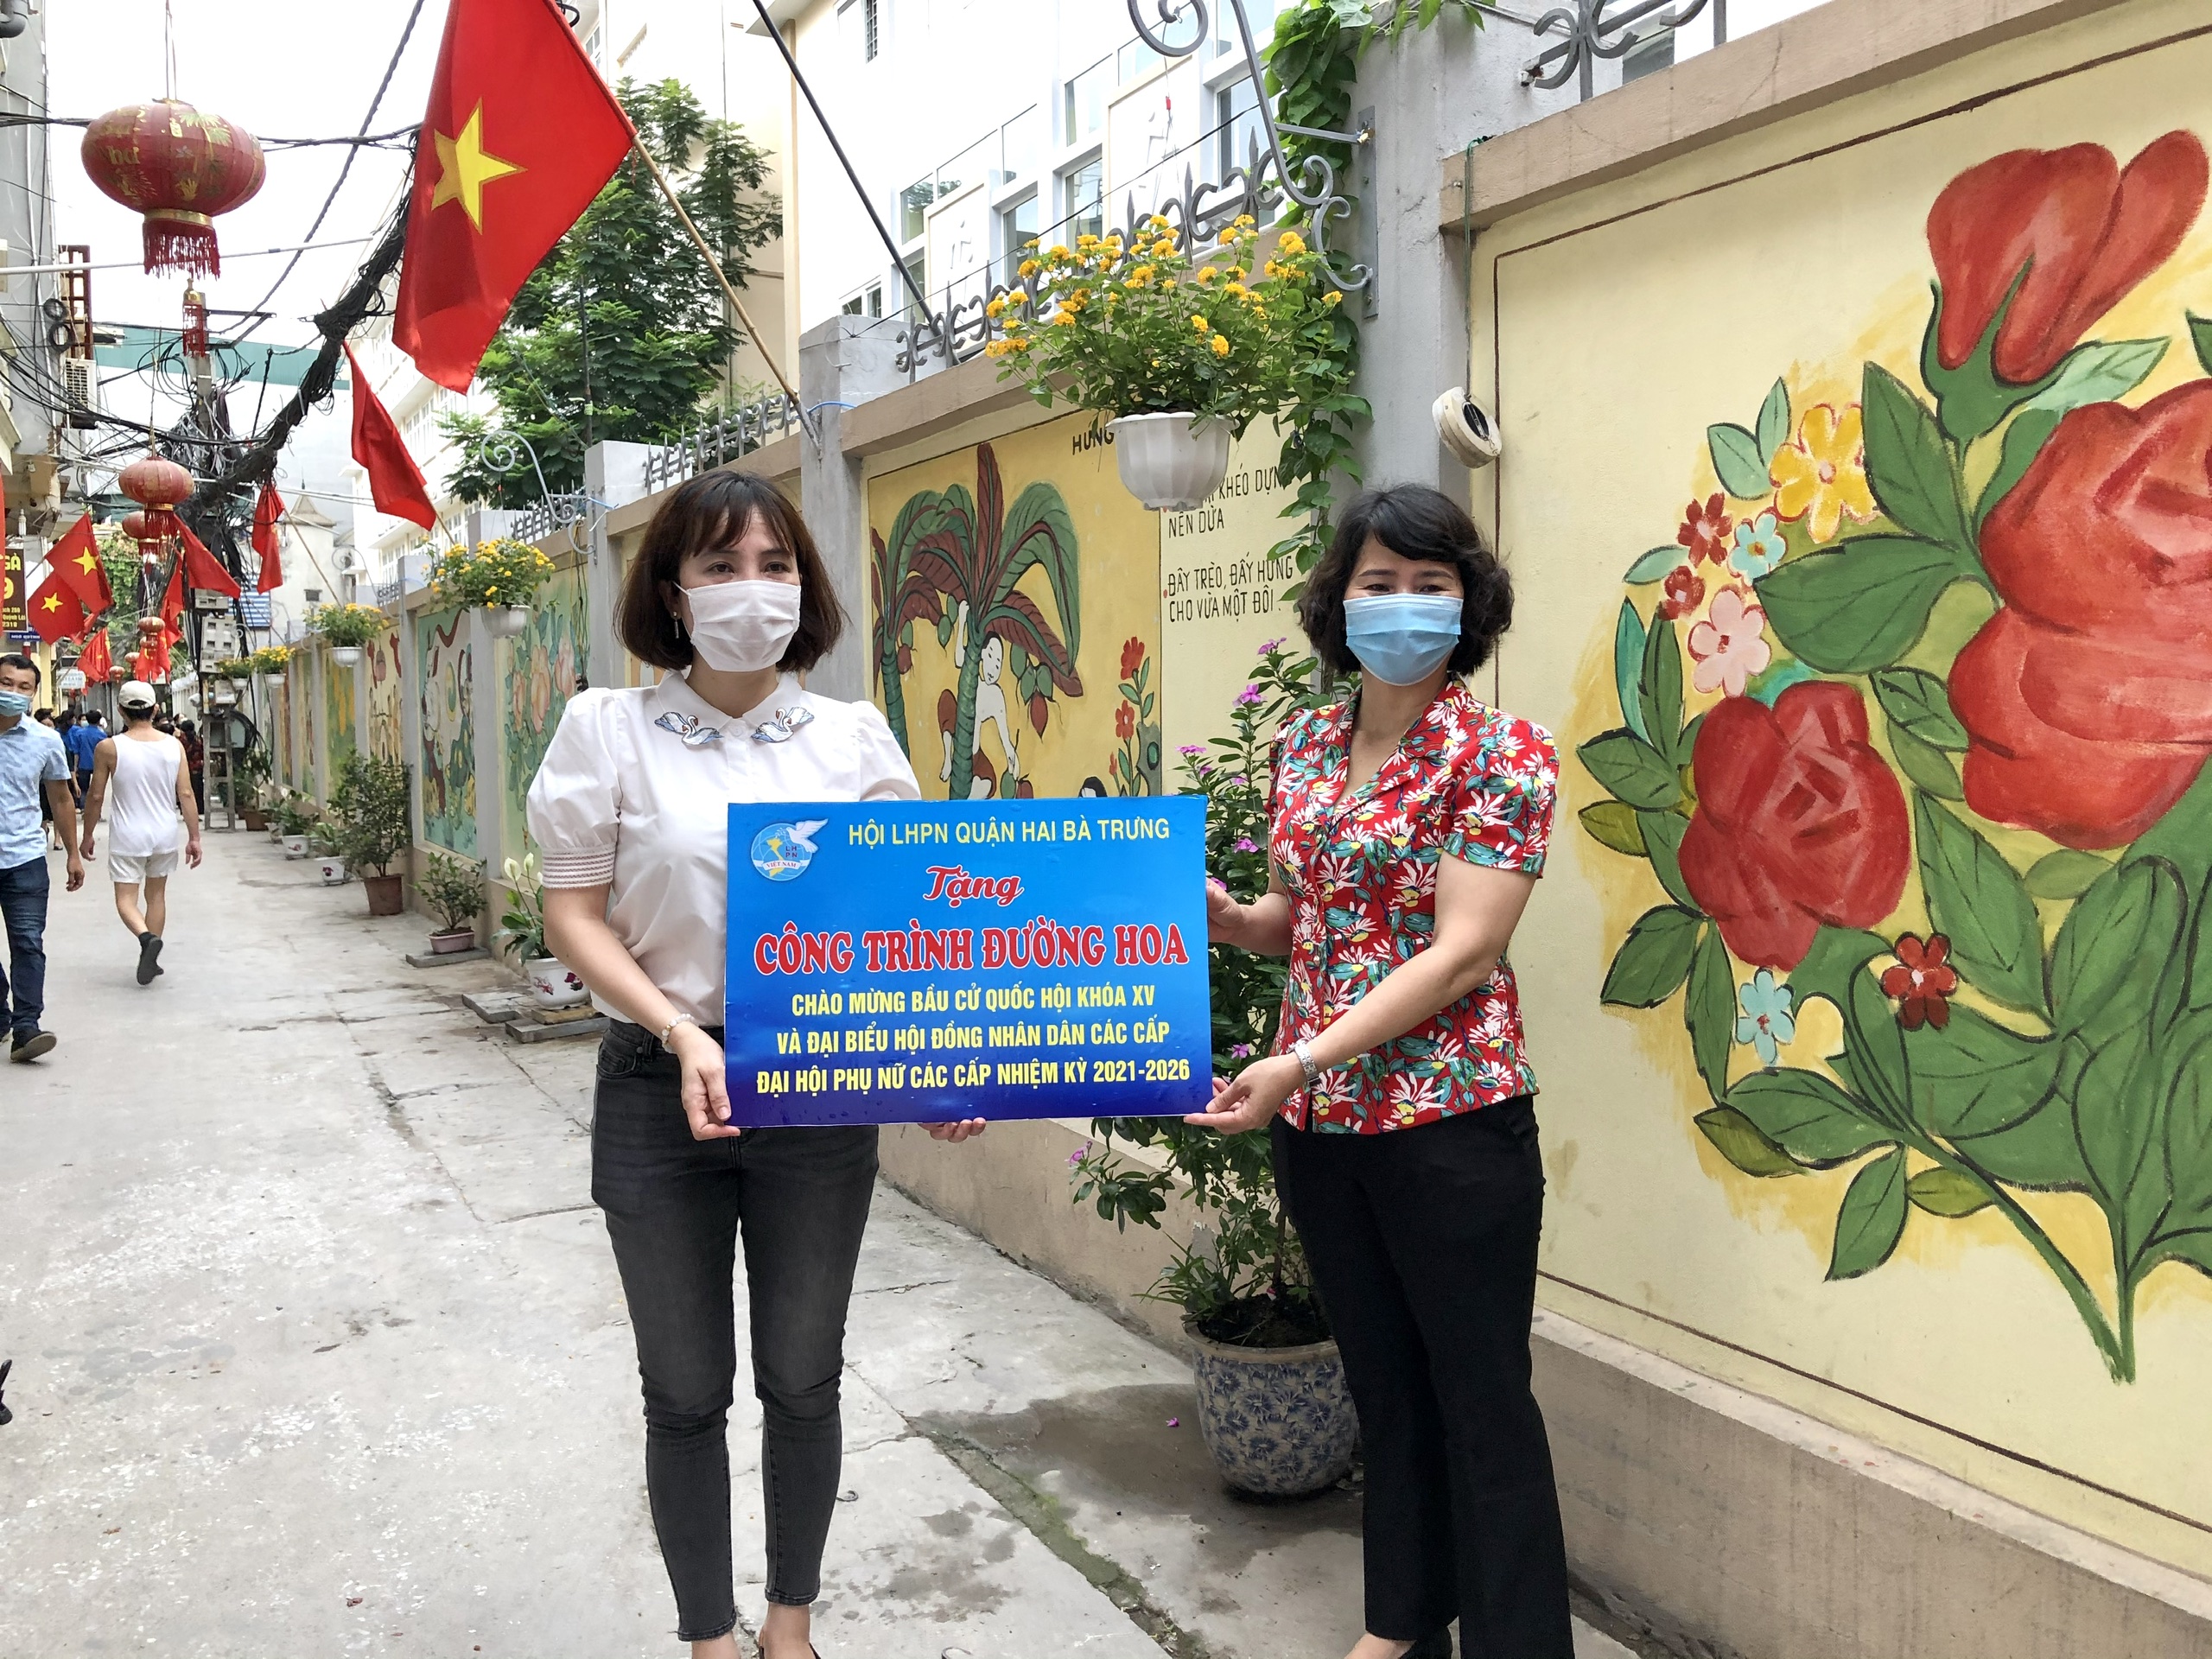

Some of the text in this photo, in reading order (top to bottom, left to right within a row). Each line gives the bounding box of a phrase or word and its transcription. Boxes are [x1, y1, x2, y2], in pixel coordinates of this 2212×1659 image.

[1219, 462, 1249, 499] KHÉO
[1255, 465, 1282, 495] DỰN
[1168, 505, 1224, 538] NÊN DỪA
[1167, 567, 1190, 596] ĐÂY
[1194, 560, 1226, 591] TRÈO,
[1229, 551, 1253, 586] ĐẤY
[1169, 595, 1192, 623] CHO
[1197, 591, 1219, 619] VỪA
[1223, 588, 1248, 622] MỘT
[849, 815, 1169, 849] HỘI LHPN QUẬN HAI BÀ TRƯNG
[923, 864, 1025, 908] Tặng
[754, 915, 1189, 976] CÔNG TRÌNH ĐƯỜNG HOA
[792, 981, 1154, 1016] CHÀO MỪNG BẦU CỬ QUỐC HỘI KHÓA XV
[777, 1014, 1170, 1058] VÀ ĐẠI BIỂU HỘI ĐỒNG NHÂN DÂN CÁC CẤP
[757, 1057, 1190, 1097] ĐẠI HỘI PHỤ NỮ CÁC CẤP NHIỆM KỲ 2021-2026
